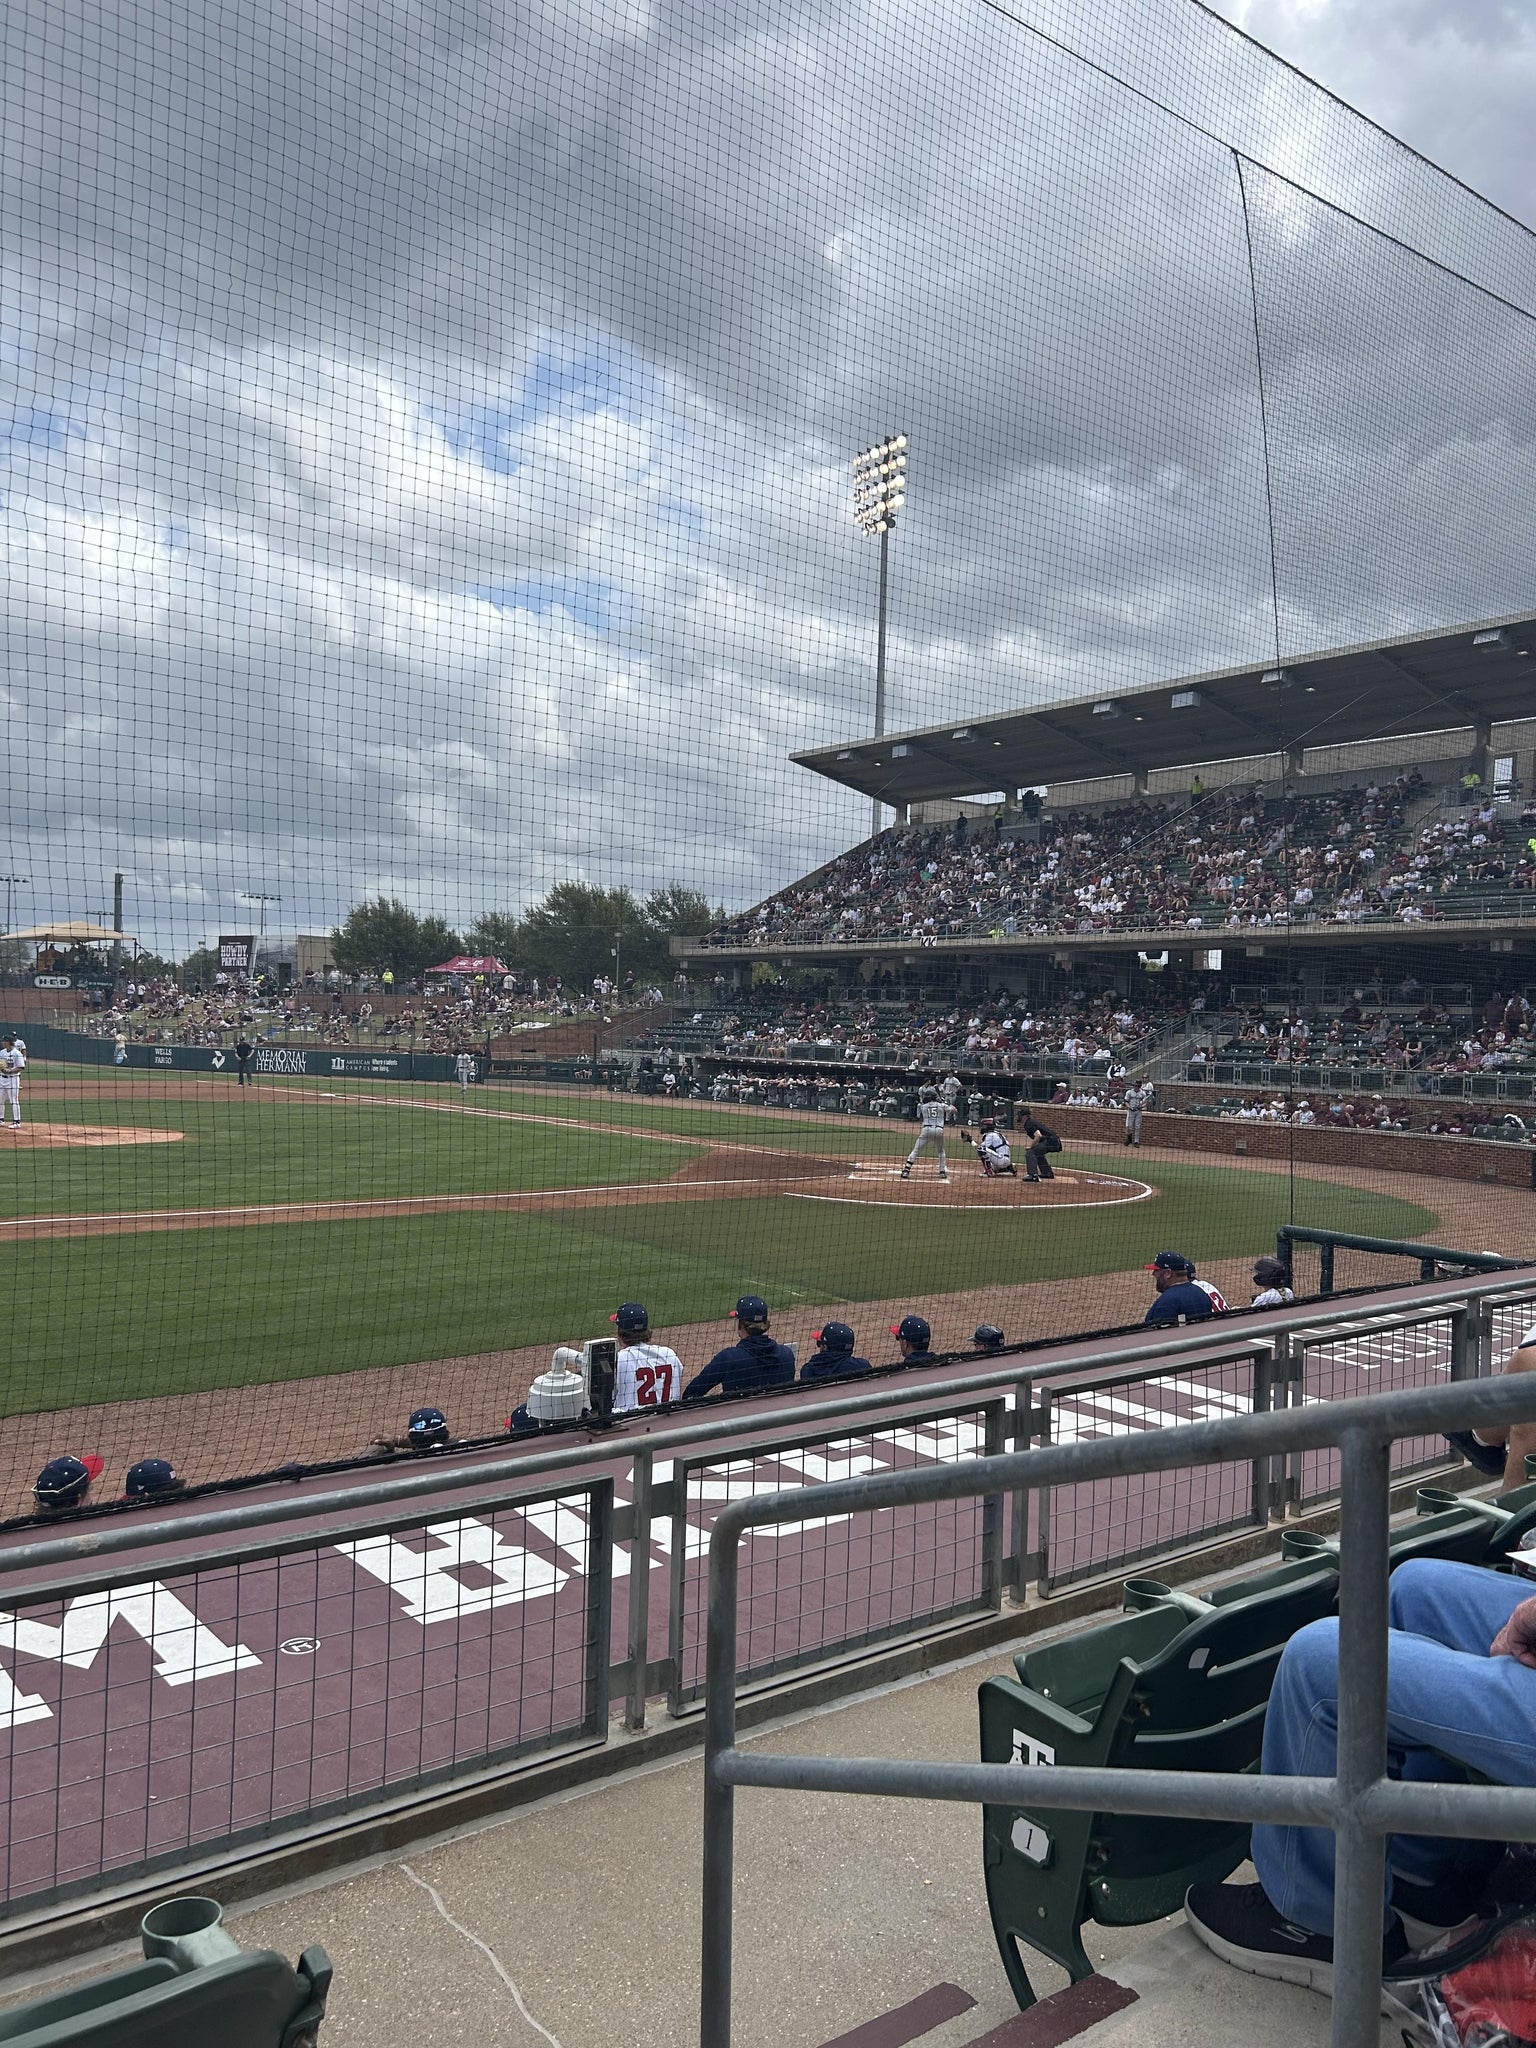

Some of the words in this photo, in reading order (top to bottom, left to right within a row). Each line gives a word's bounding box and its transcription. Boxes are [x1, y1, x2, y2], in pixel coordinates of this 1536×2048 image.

[221, 957, 248, 967] PARTNER
[155, 1048, 172, 1056] WELLS
[256, 1050, 307, 1063] MEMORIAL
[154, 1057, 173, 1065] FARGO
[256, 1060, 306, 1073] HERMANN
[928, 1107, 938, 1118] 15
[636, 1364, 672, 1405] 27
[1026, 1828, 1034, 1851] 1
